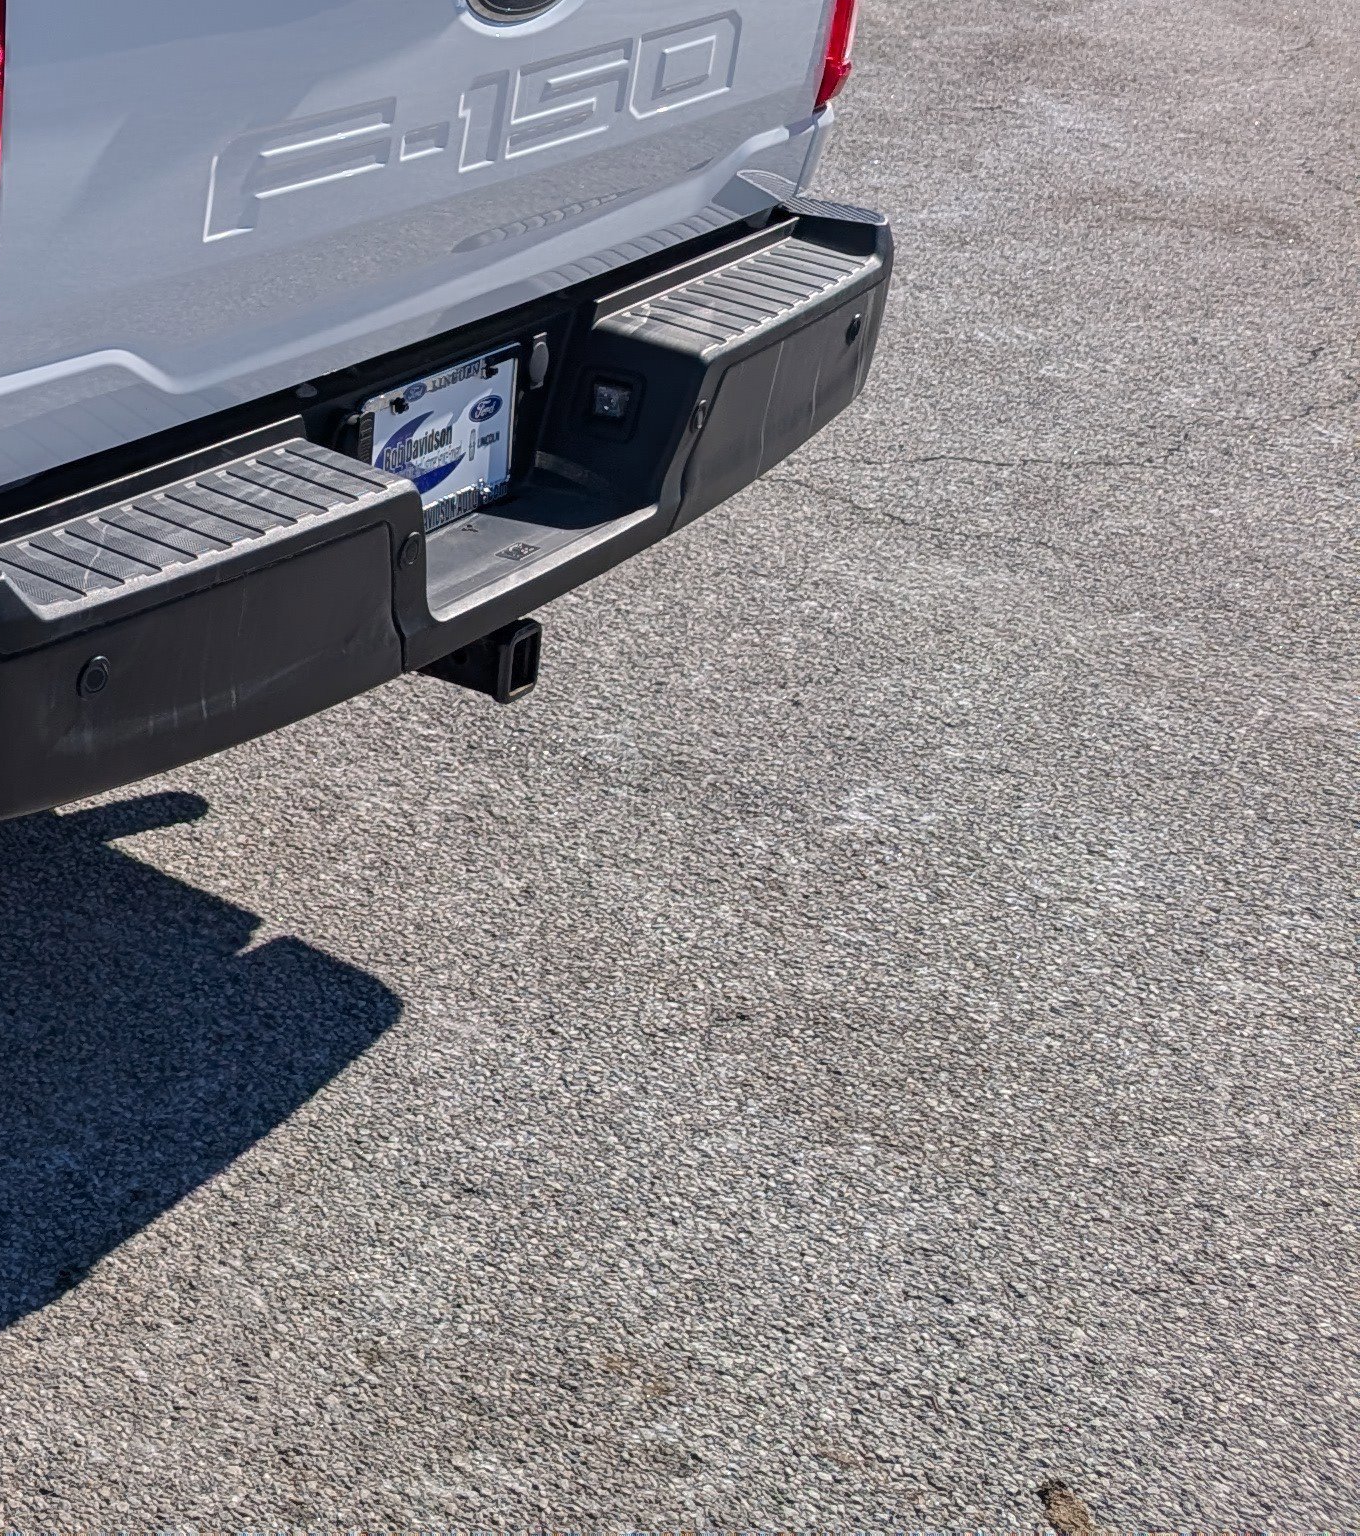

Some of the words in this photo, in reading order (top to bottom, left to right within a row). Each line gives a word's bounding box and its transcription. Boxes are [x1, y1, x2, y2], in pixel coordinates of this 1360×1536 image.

[203, 9, 743, 242] F-150
[473, 398, 498, 420] Ford
[384, 441, 405, 471] Bob
[406, 426, 453, 462] Davidson
